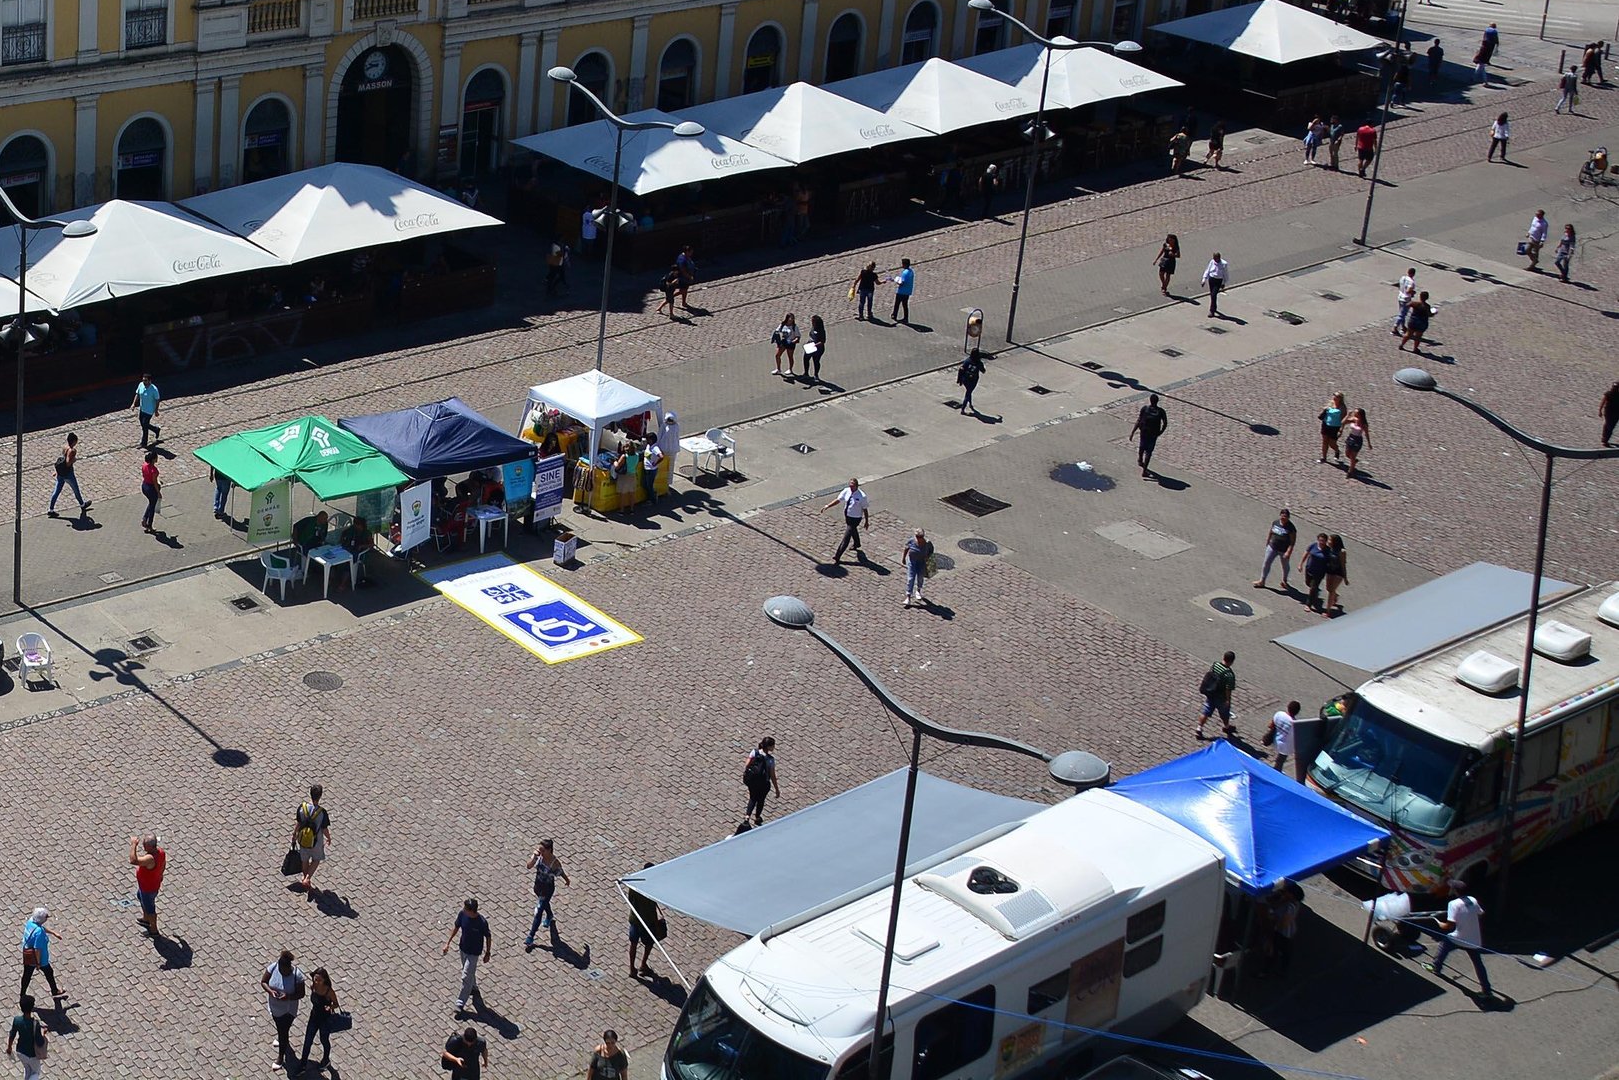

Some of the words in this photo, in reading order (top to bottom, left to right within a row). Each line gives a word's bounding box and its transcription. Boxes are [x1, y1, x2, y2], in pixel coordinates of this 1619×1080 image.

[358, 80, 393, 92] MASSON
[394, 212, 439, 232] Coca-Cola
[172, 254, 221, 274] Coca-Cola
[540, 469, 561, 483] SINE
